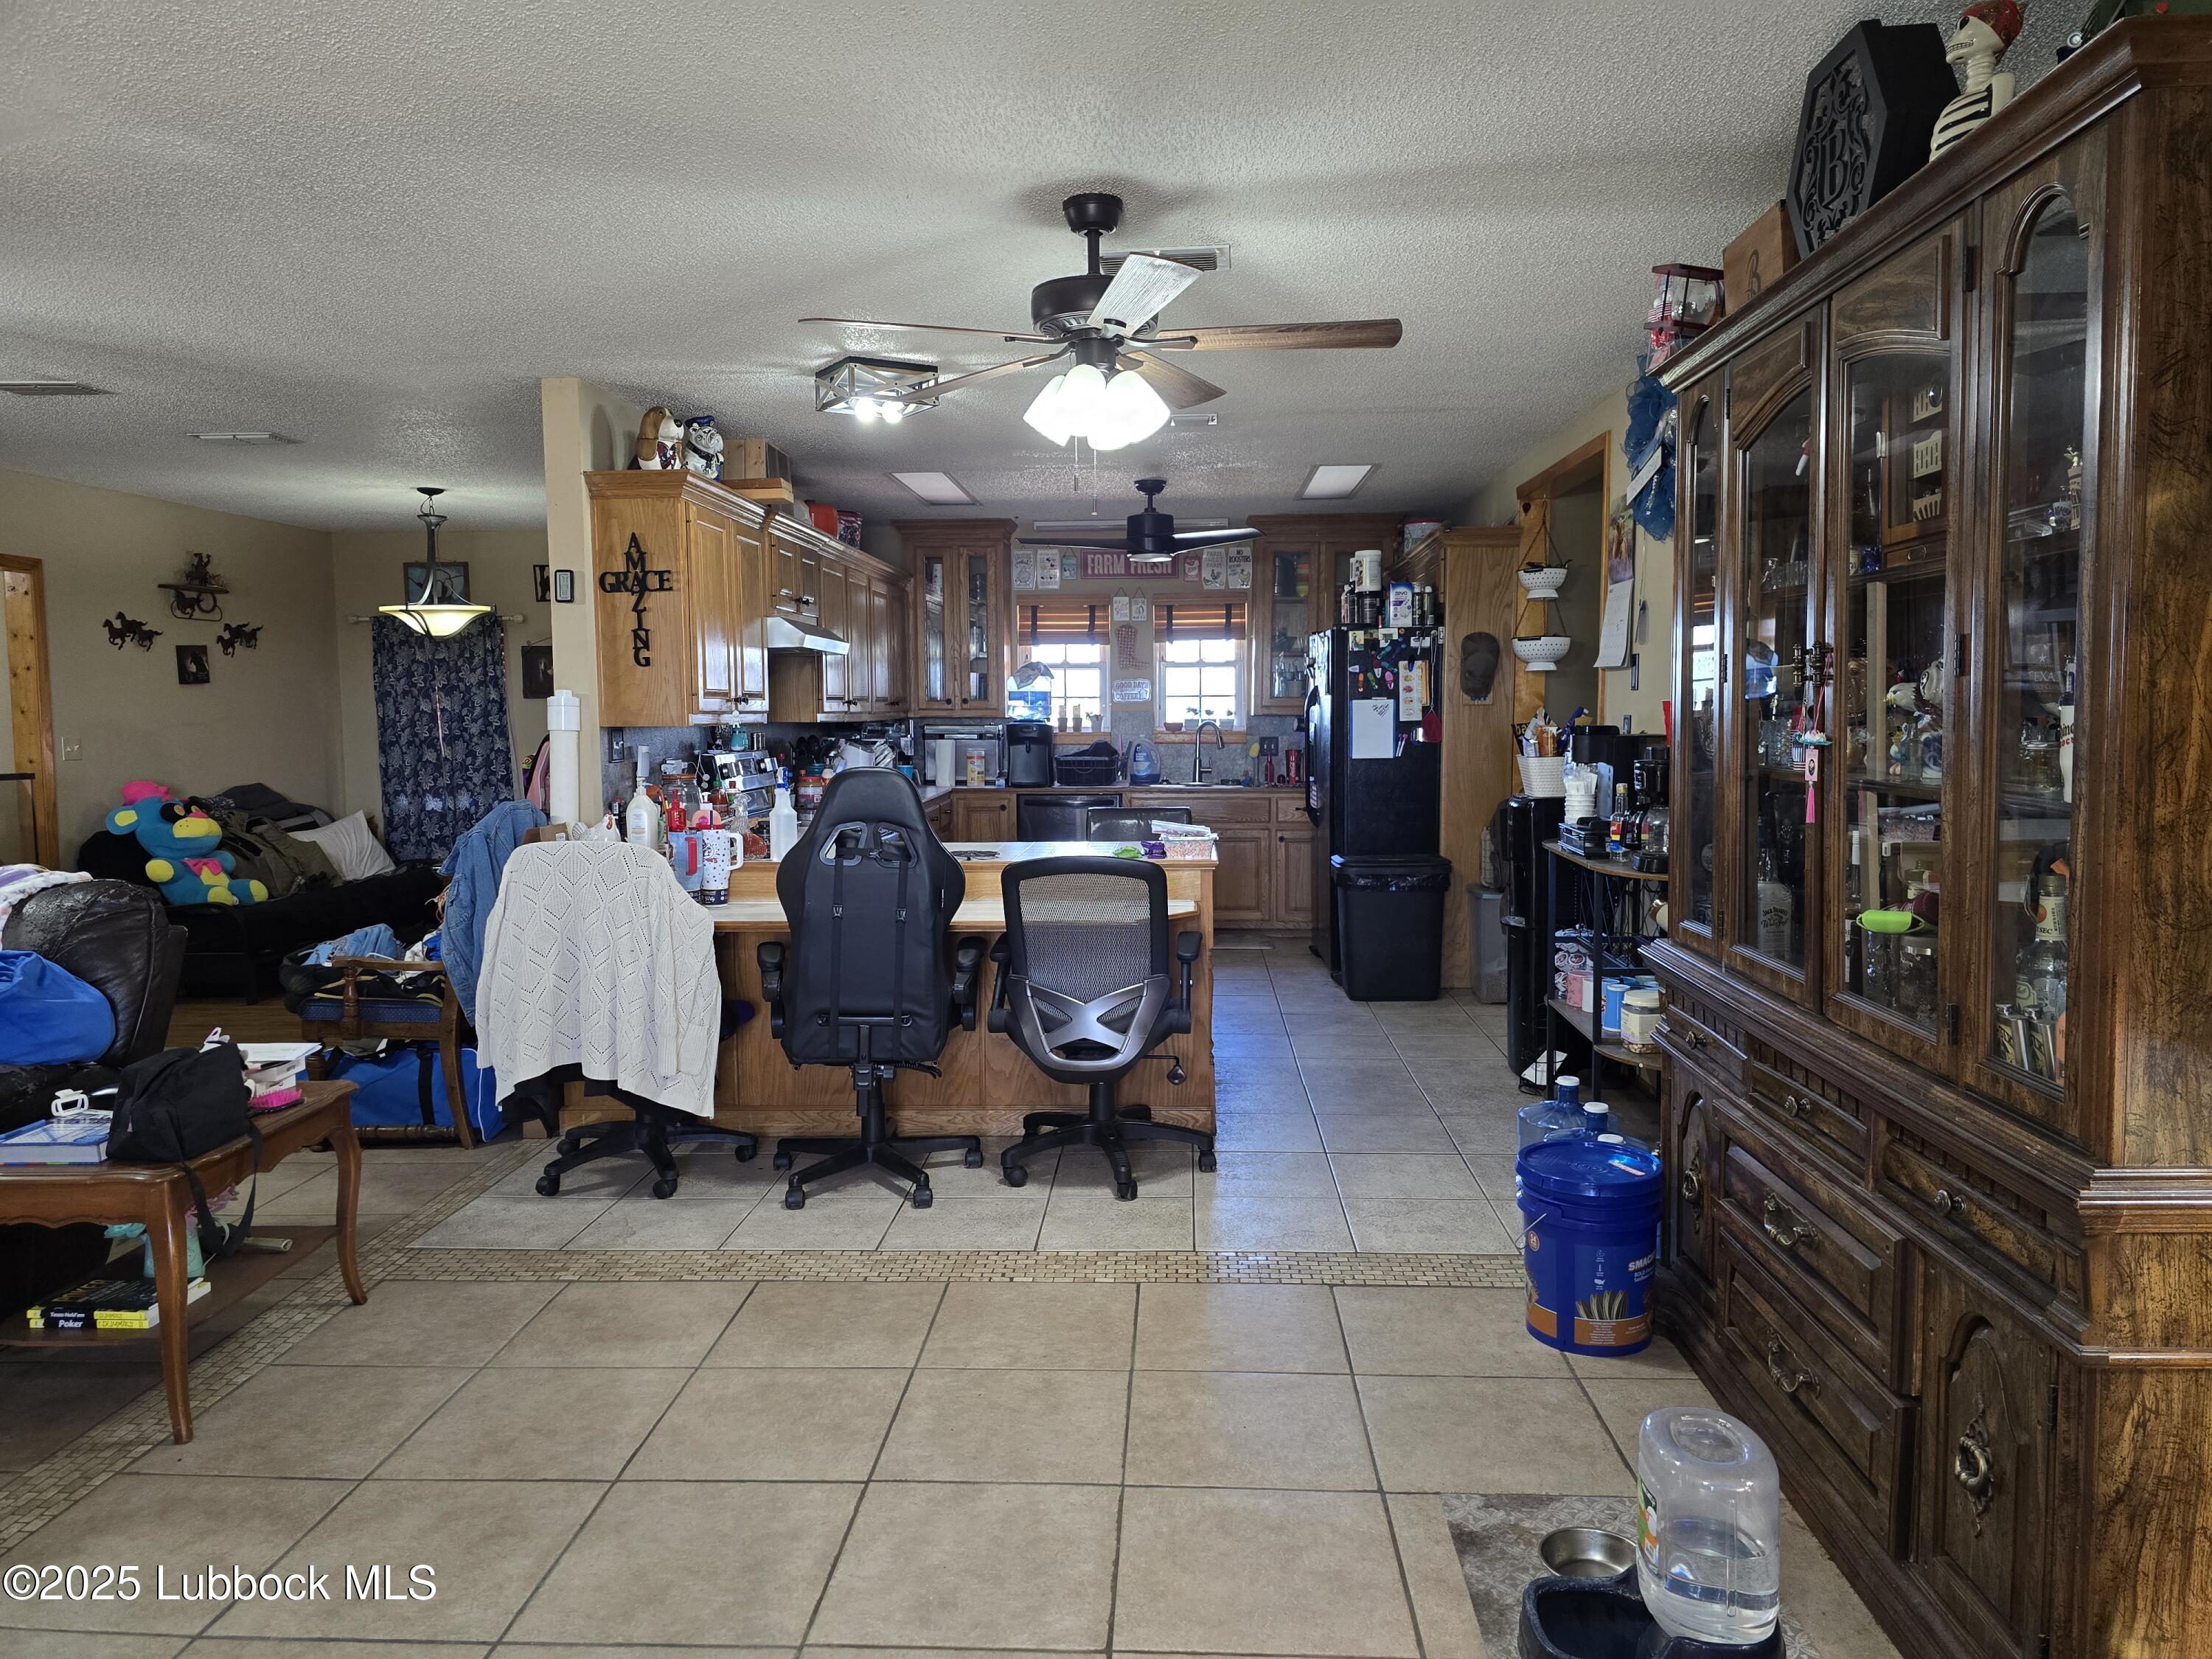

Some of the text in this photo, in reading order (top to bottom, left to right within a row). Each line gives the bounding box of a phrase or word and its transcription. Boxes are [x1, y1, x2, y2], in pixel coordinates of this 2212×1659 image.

[1087, 554, 1172, 574] FARM FRESH
[599, 570, 672, 593] GRACE
[1116, 681, 1133, 689] GOOD
[58, 1320, 83, 1328] Poker
